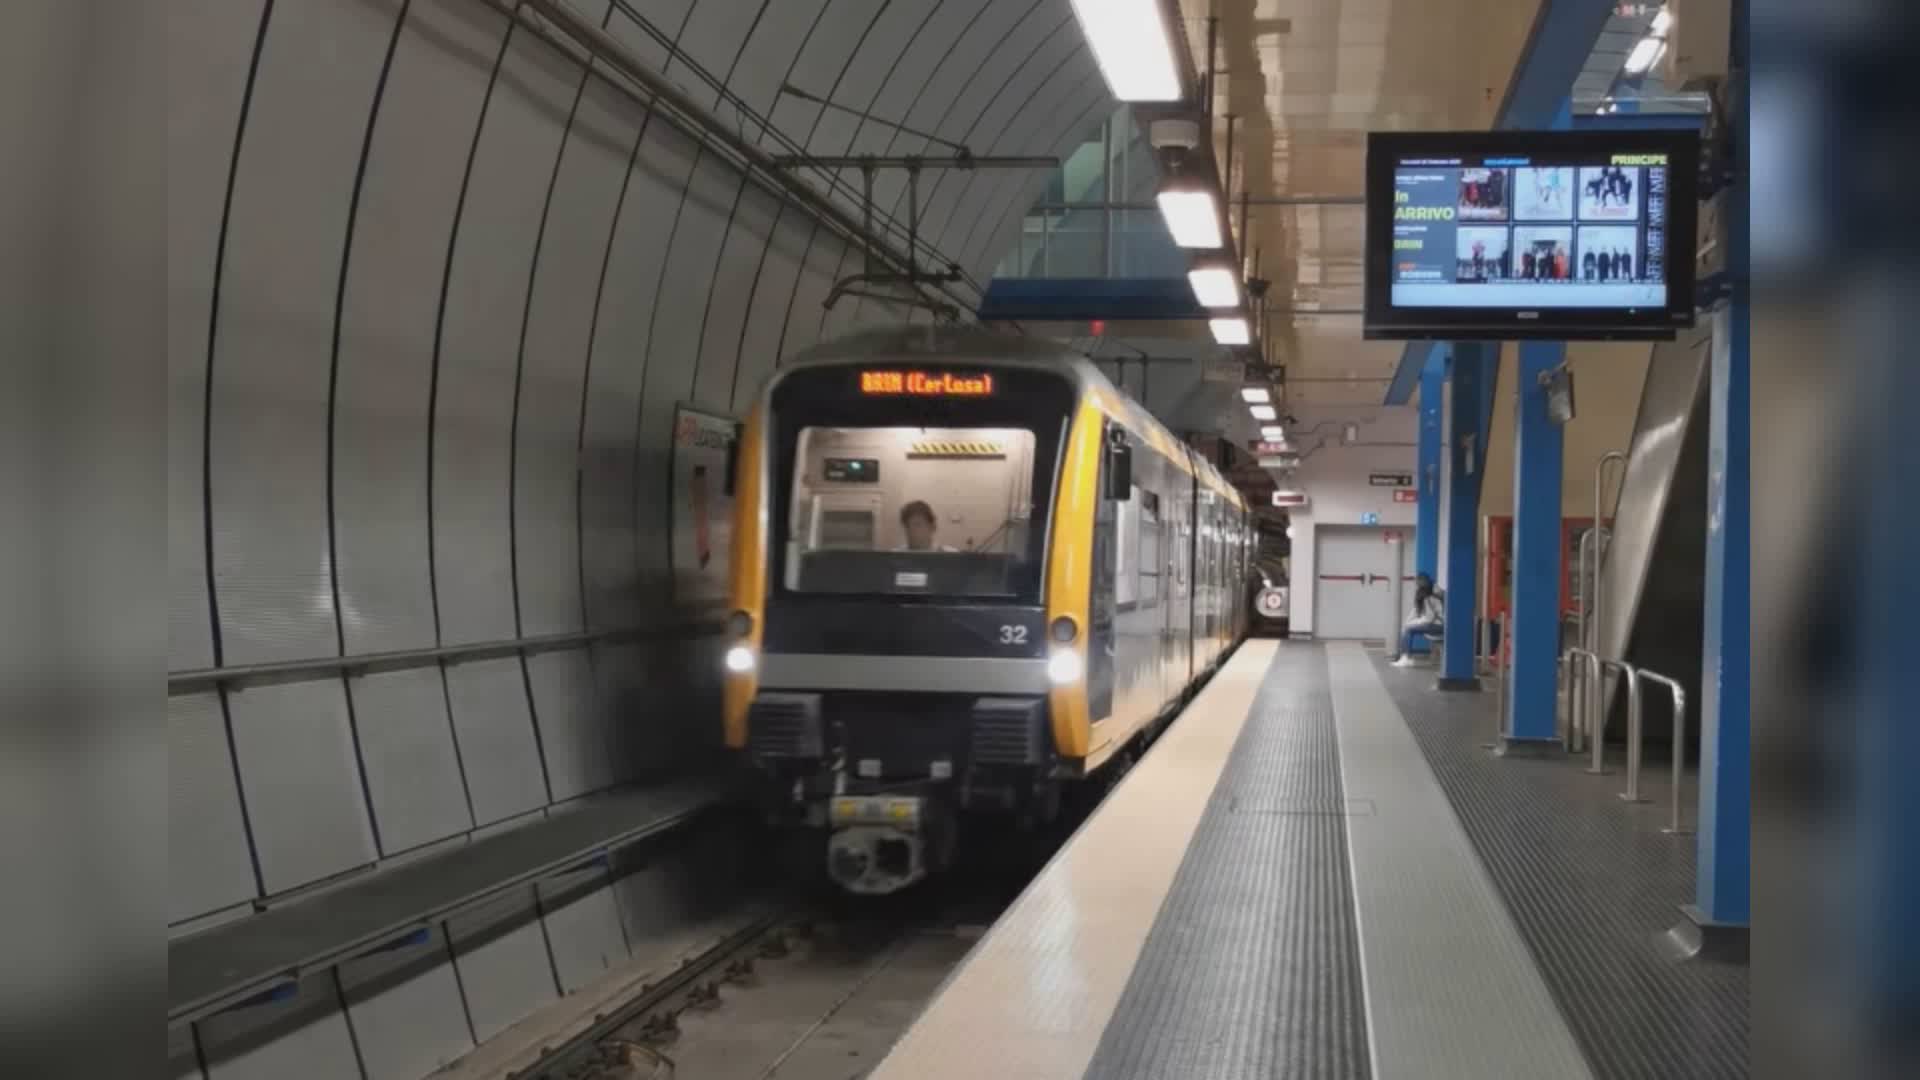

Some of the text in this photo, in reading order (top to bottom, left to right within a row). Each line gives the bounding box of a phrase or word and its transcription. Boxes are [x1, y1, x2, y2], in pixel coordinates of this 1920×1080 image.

[1611, 154, 1668, 166] PRINCIPE
[1395, 190, 1409, 203] In
[1394, 207, 1455, 220] ARRIVO
[999, 625, 1028, 644] 32
